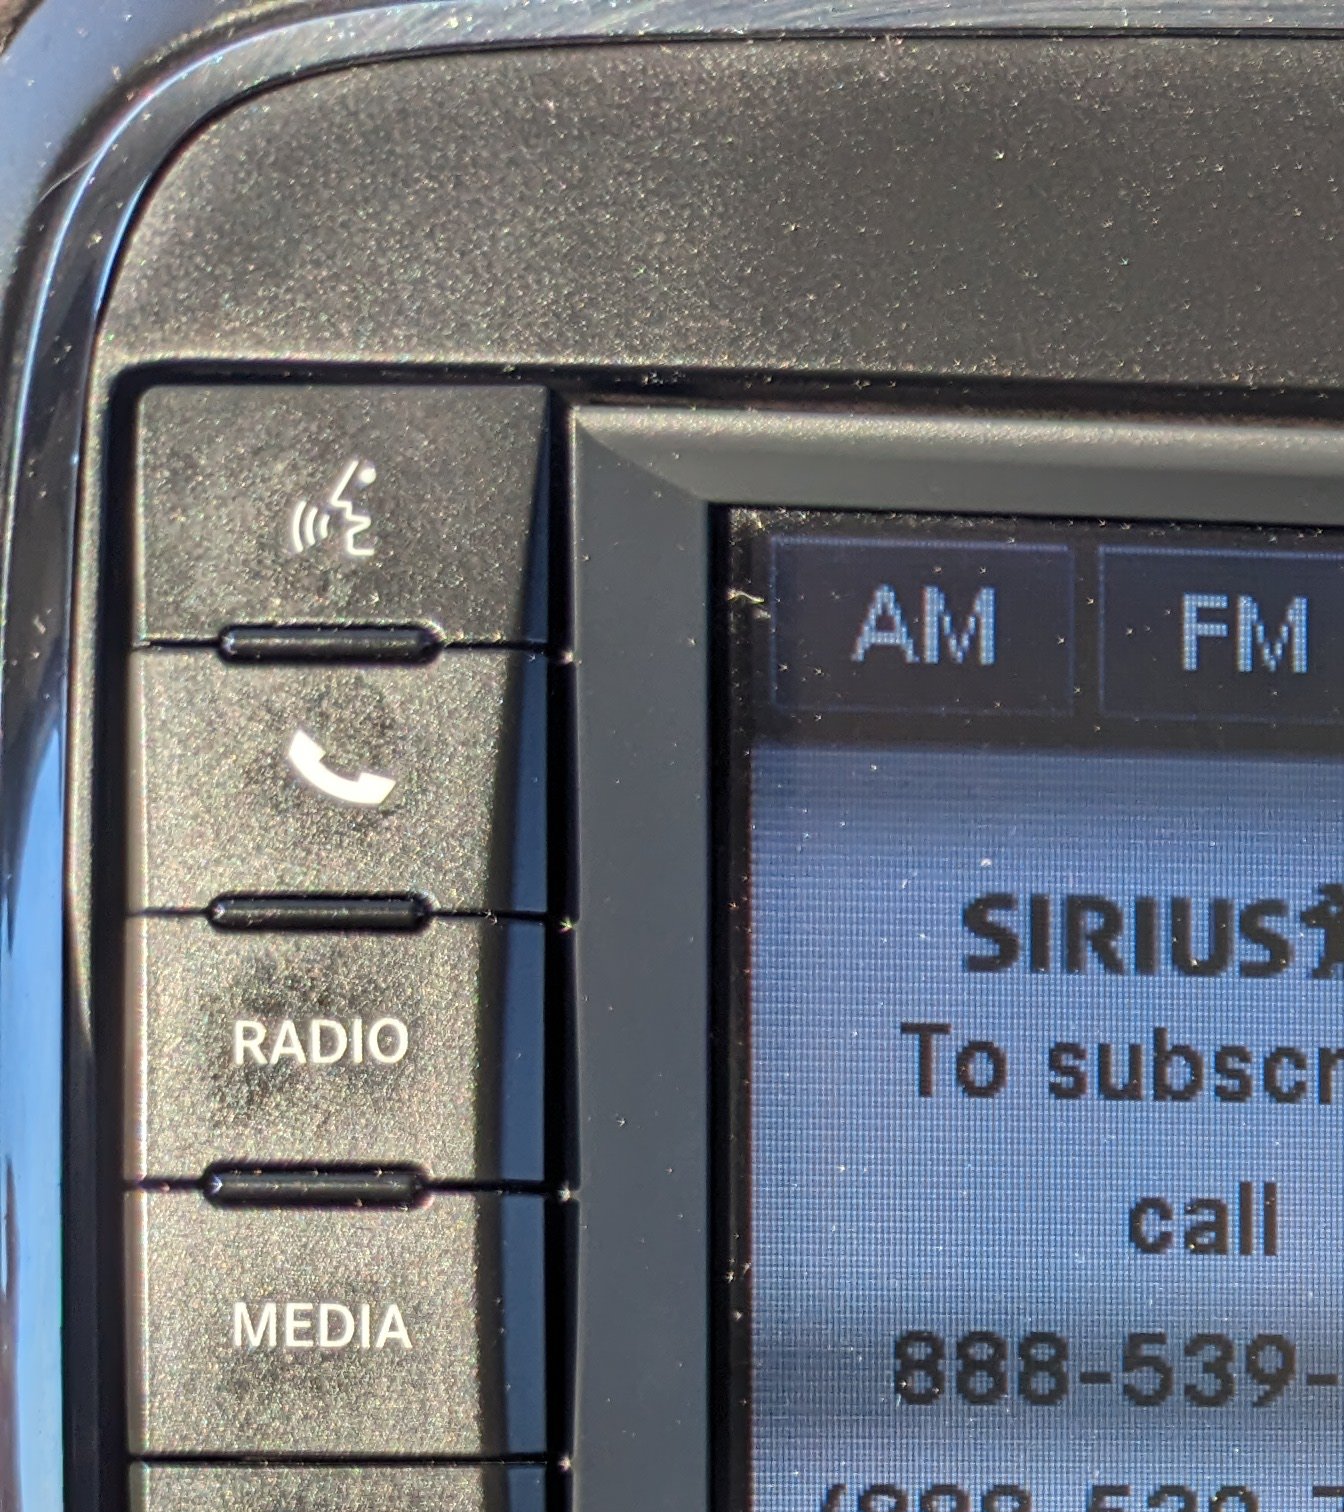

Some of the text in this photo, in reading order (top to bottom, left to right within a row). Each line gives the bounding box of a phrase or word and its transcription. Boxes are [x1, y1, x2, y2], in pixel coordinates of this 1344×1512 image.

[852, 583, 996, 667] AM
[1179, 593, 1308, 674] FM
[963, 892, 1292, 979] SIRIUS
[234, 1018, 409, 1064] RADIO
[901, 1022, 1007, 1099] To
[1130, 1181, 1277, 1257] call
[233, 1302, 411, 1349] MEDIA
